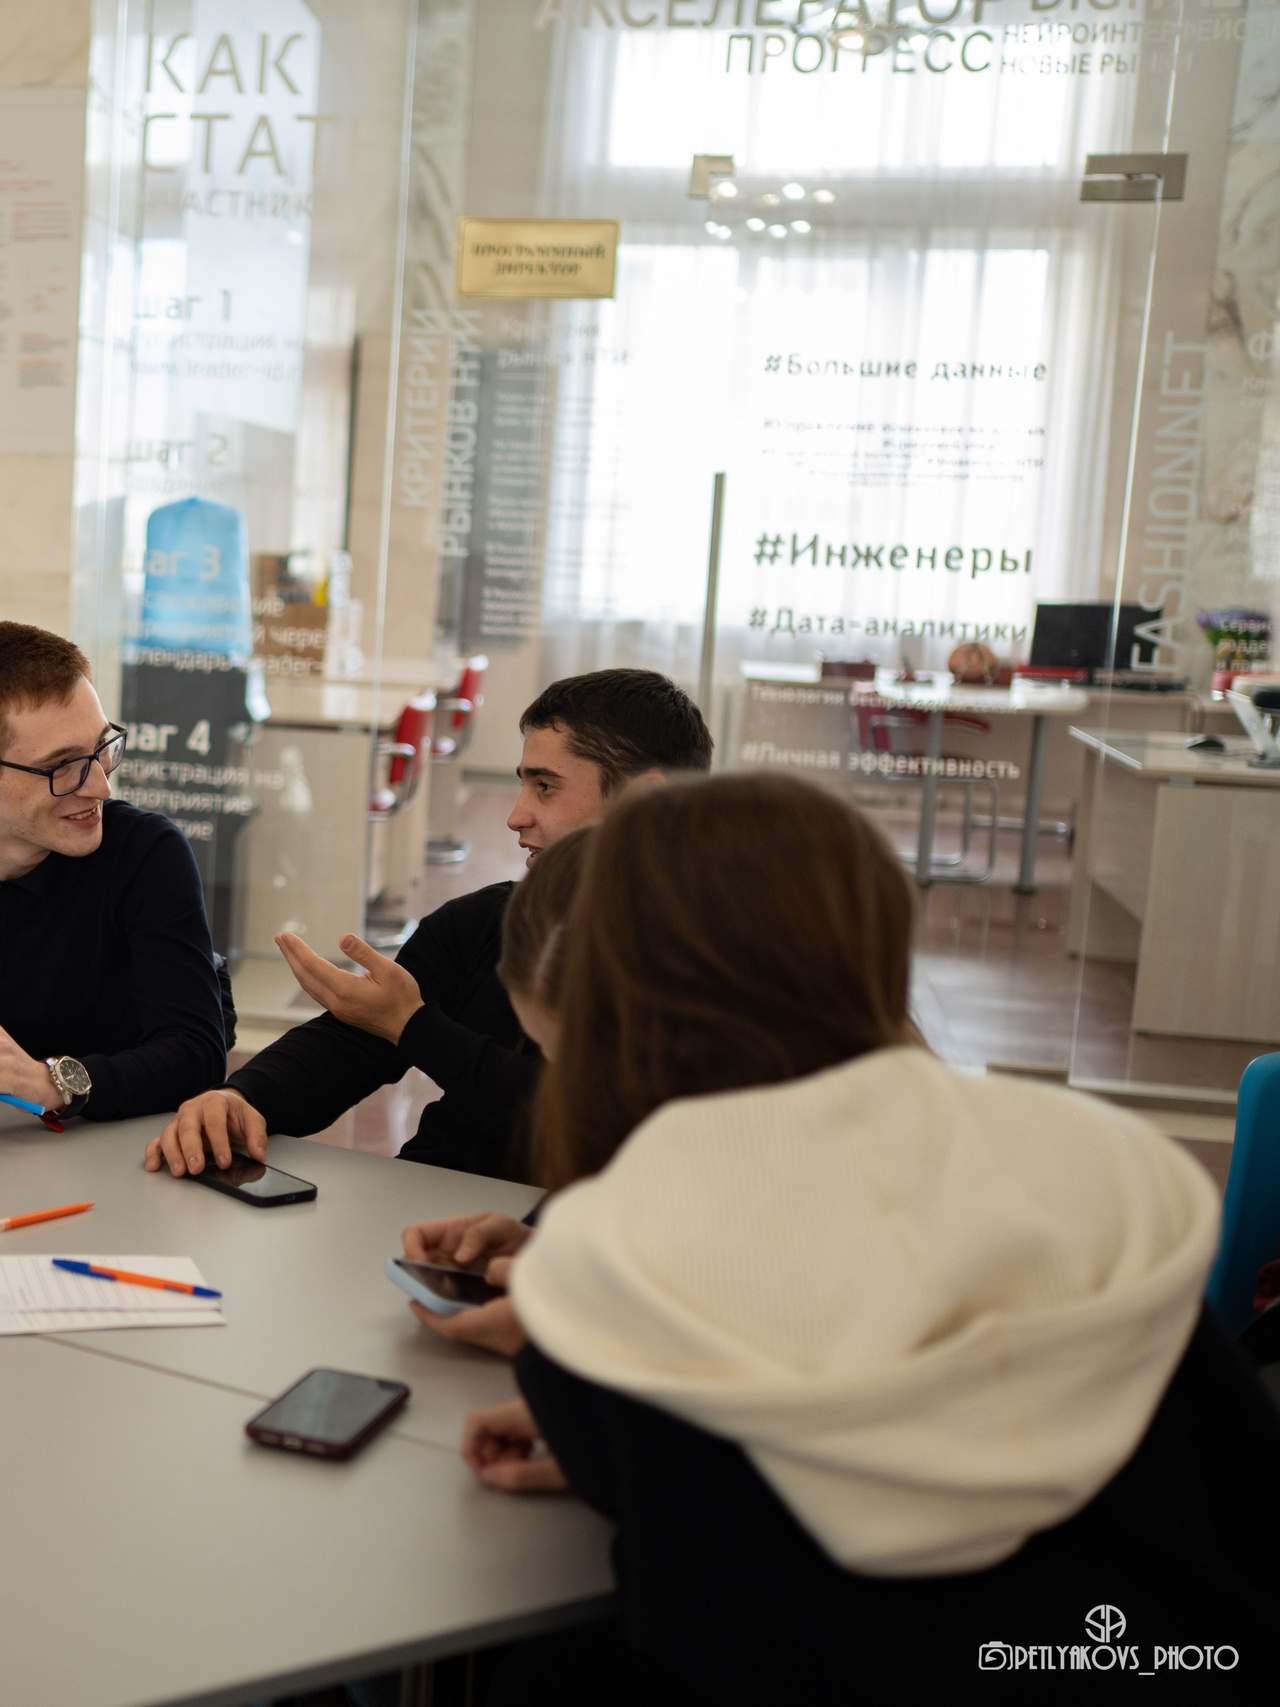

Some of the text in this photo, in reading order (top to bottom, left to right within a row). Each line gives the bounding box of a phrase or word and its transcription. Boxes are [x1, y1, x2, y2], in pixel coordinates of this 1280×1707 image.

[143, 32, 305, 97] КАК
[723, 30, 993, 74] ПРОГРЕСС
[764, 353, 918, 380] #Большие
[399, 308, 446, 508] КРИТЕРИИ
[206, 431, 230, 468] 2
[438, 308, 485, 559] РЫНКОВ НТИ
[1130, 329, 1214, 675] FASHIONNET
[200, 543, 221, 580] 3
[753, 531, 1034, 579] #Инженеры
[747, 606, 1028, 643] #Дата-аналитики
[186, 719, 211, 755] 4
[118, 758, 250, 788] егистрация
[740, 740, 1022, 782] #Личная эффективность
[118, 785, 254, 816] ероприятие
